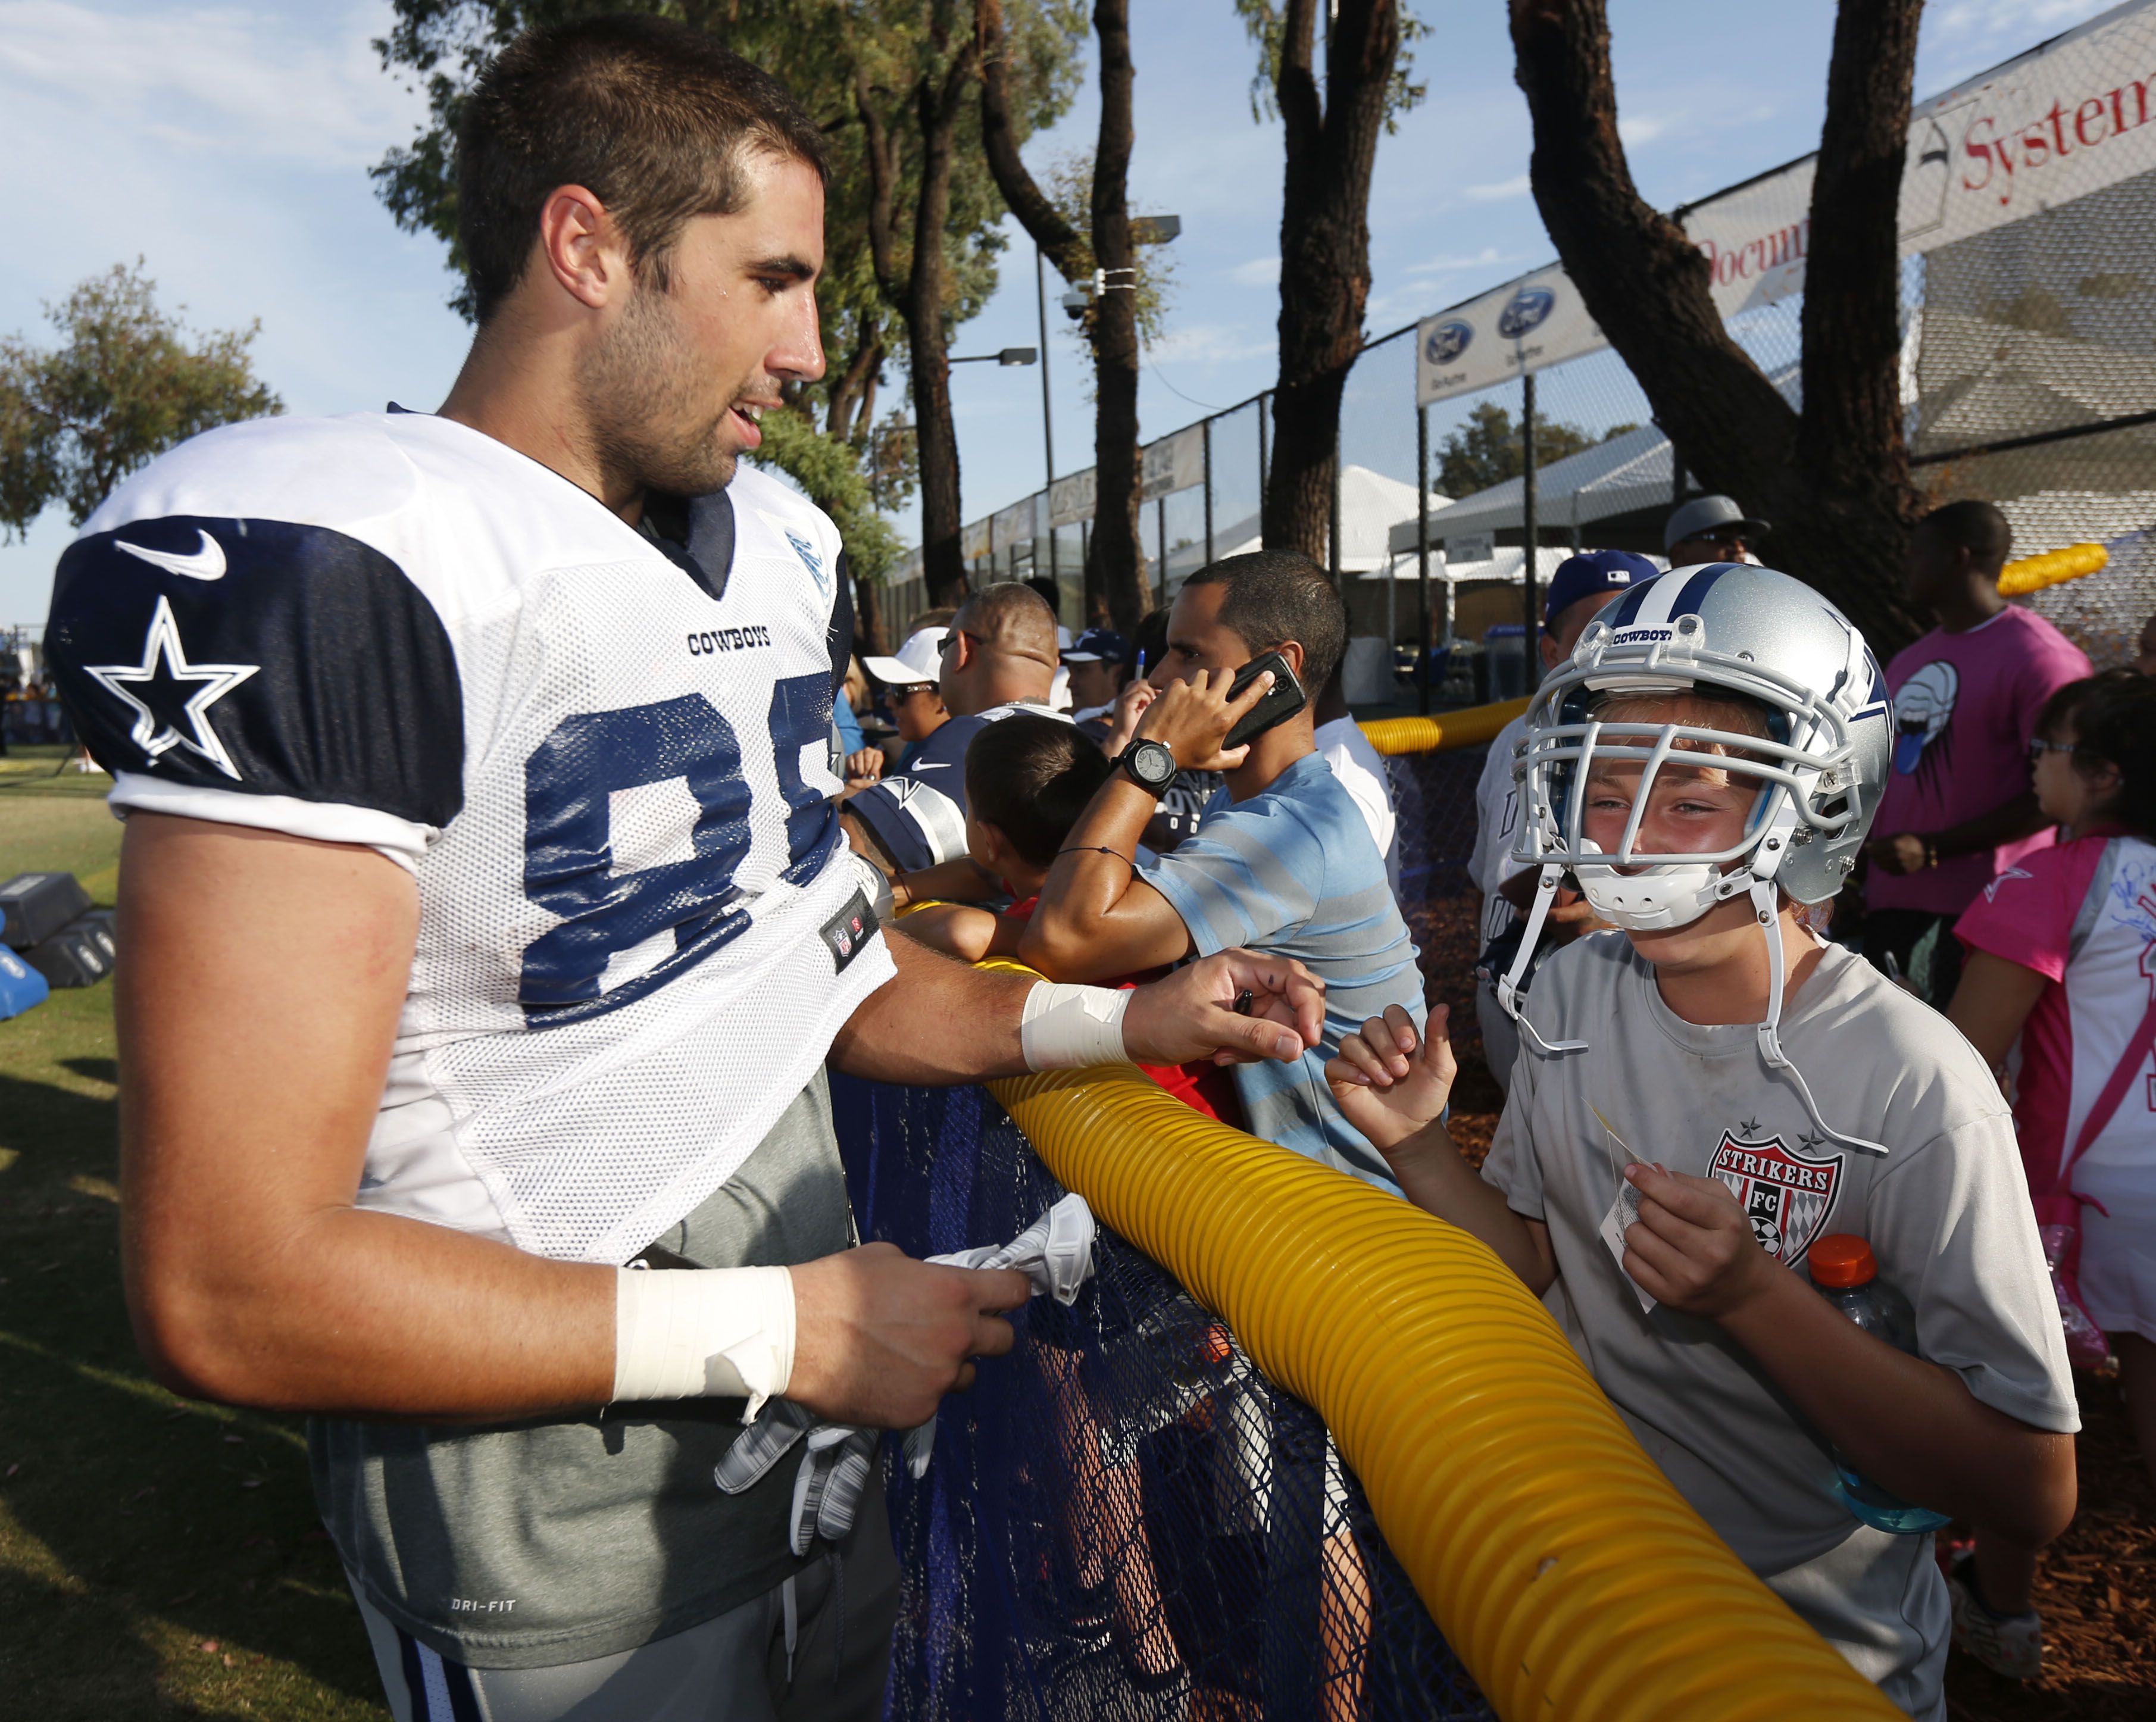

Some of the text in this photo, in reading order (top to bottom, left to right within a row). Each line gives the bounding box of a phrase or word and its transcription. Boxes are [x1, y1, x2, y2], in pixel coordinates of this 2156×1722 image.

[688, 625, 771, 657] COWBOYS
[1718, 1149, 1829, 1191] STRIKERS
[1751, 1190, 1778, 1212] FC
[451, 1598, 516, 1612] DRI-FIT
